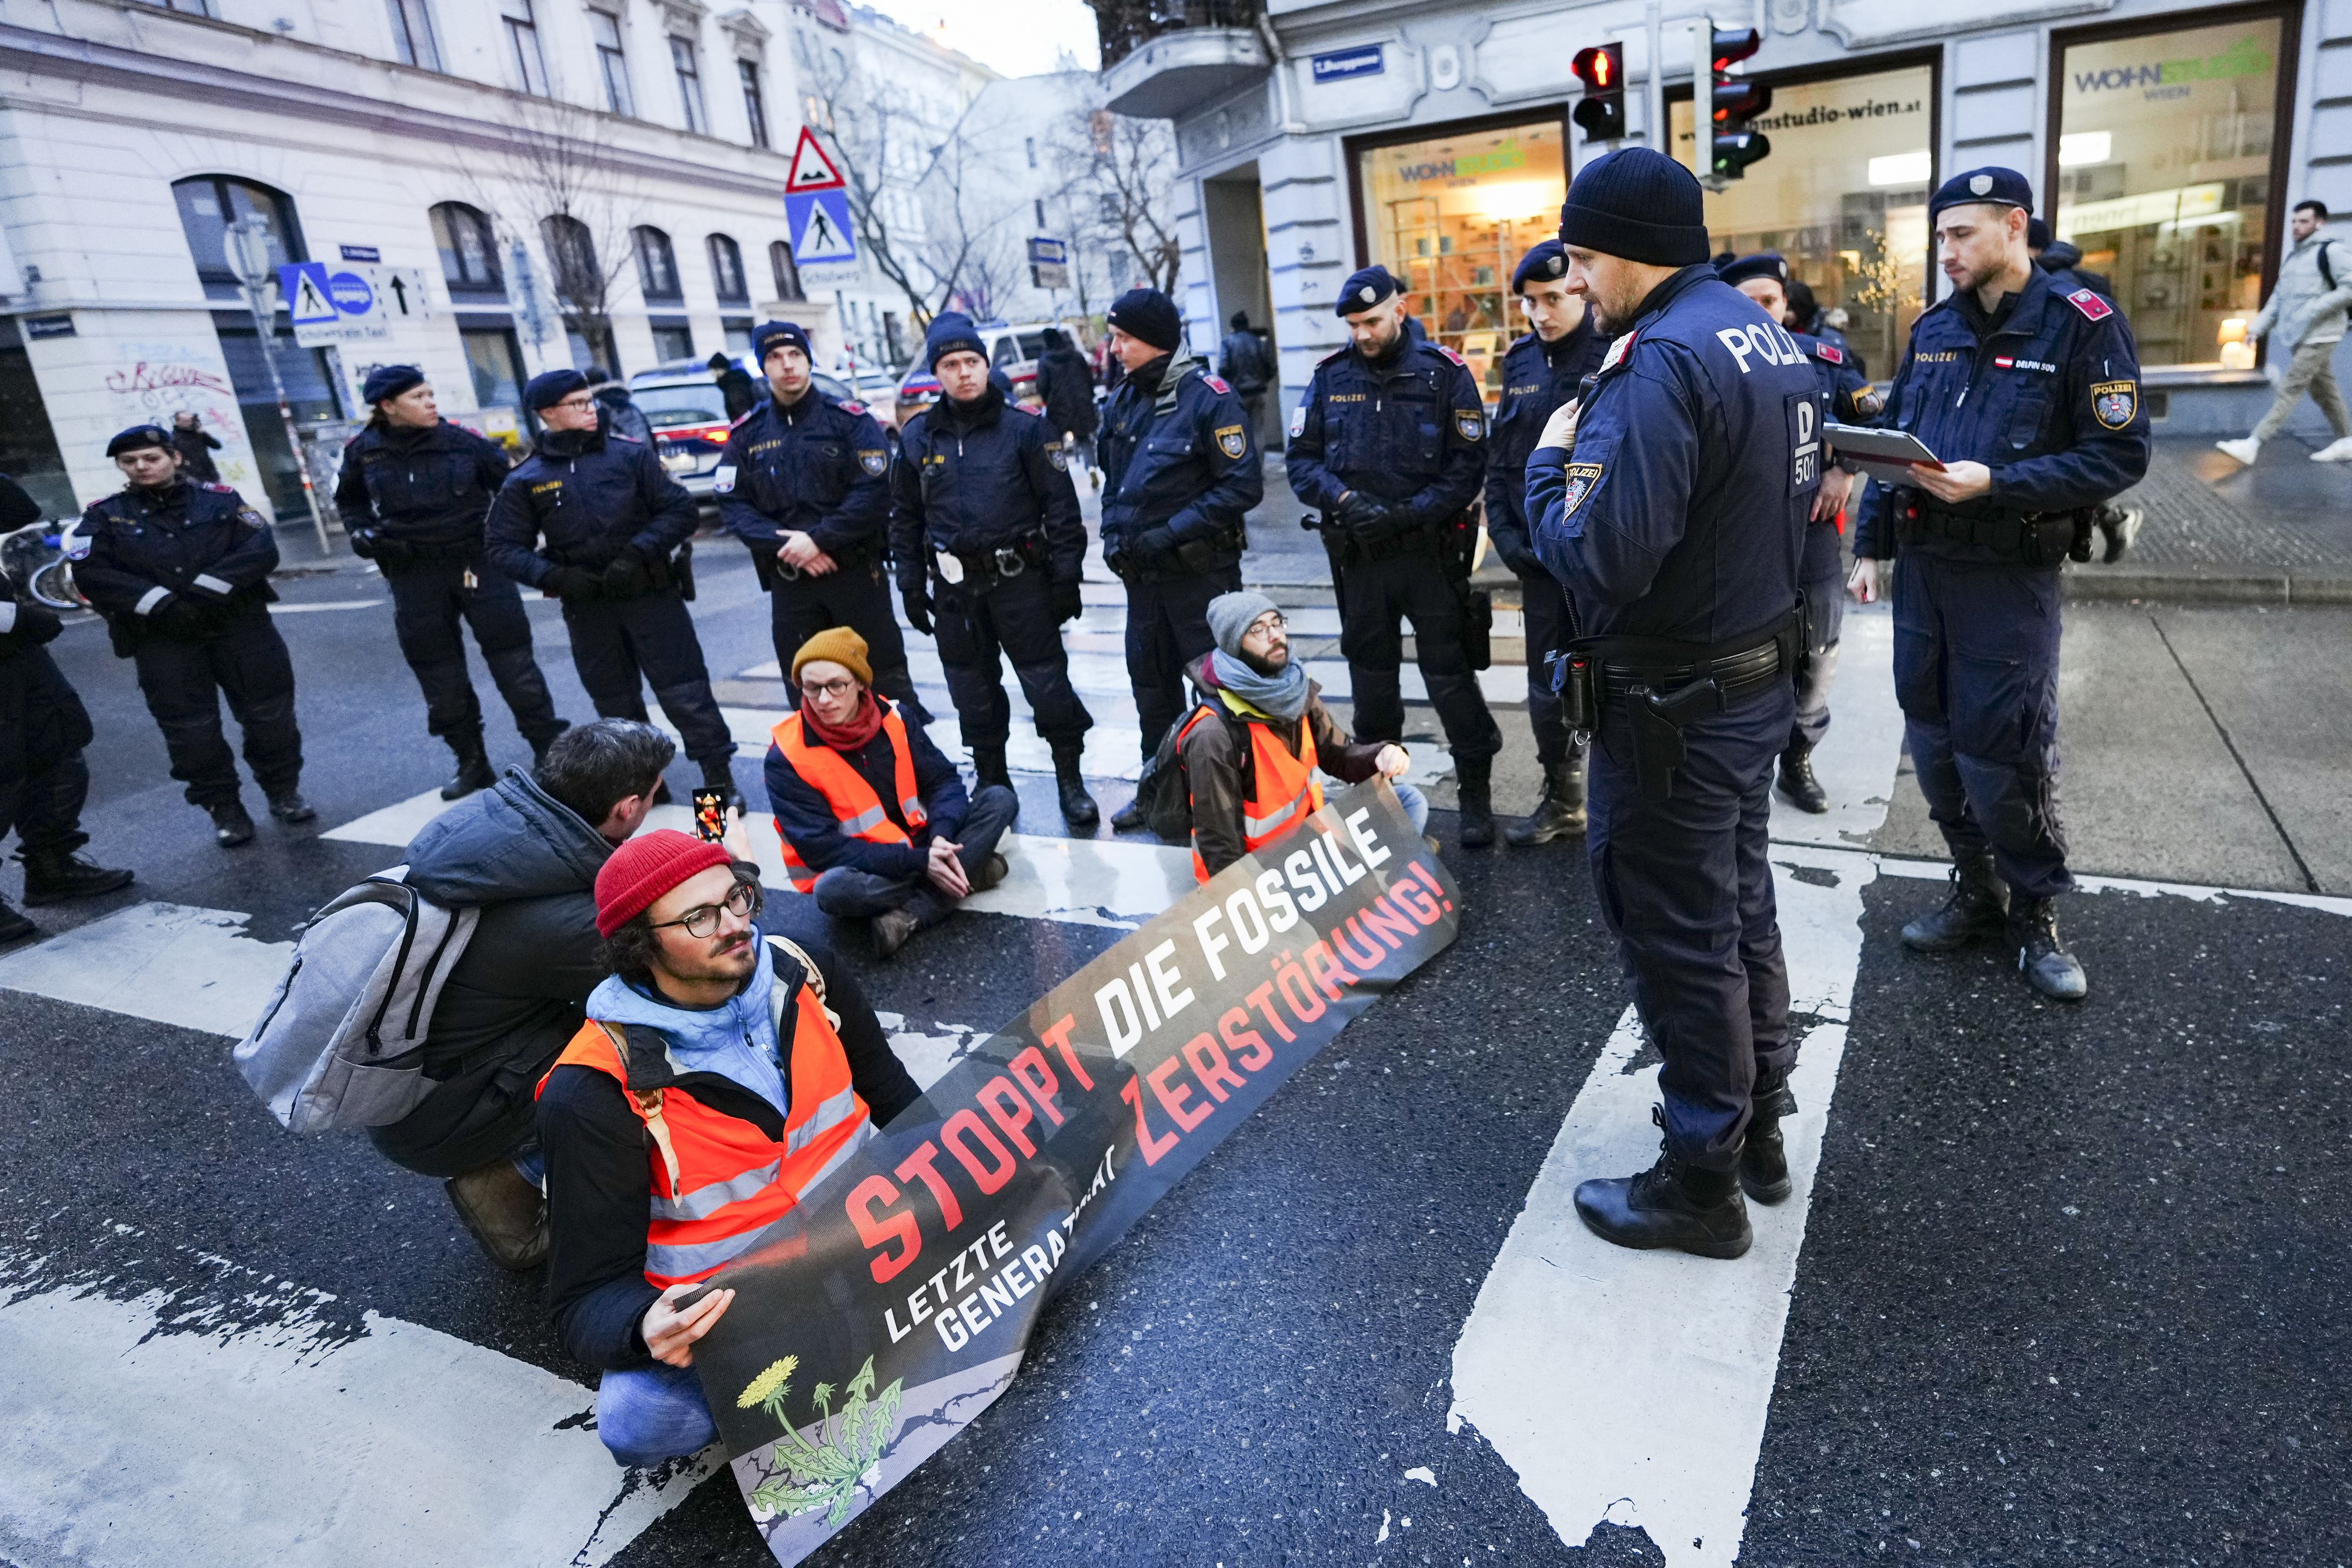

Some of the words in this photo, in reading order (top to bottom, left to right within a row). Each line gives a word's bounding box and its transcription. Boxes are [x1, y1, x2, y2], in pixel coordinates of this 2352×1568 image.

[1915, 352, 1957, 363] POLIZEI
[2016, 360, 2040, 370] DELFIN
[2040, 363, 2056, 373] 500
[1329, 394, 1366, 403] POLIZEI
[2094, 383, 2132, 396] POLIZEI
[1798, 401, 1814, 444] D
[1795, 453, 1815, 485] 501
[1120, 861, 1454, 1167] ZERSTÖRUNG!
[845, 1013, 1095, 1284] STOPPT
[1094, 938, 1196, 1059] DIE
[1192, 806, 1392, 982] FOSSILE
[884, 1219, 1014, 1344] LETZTE
